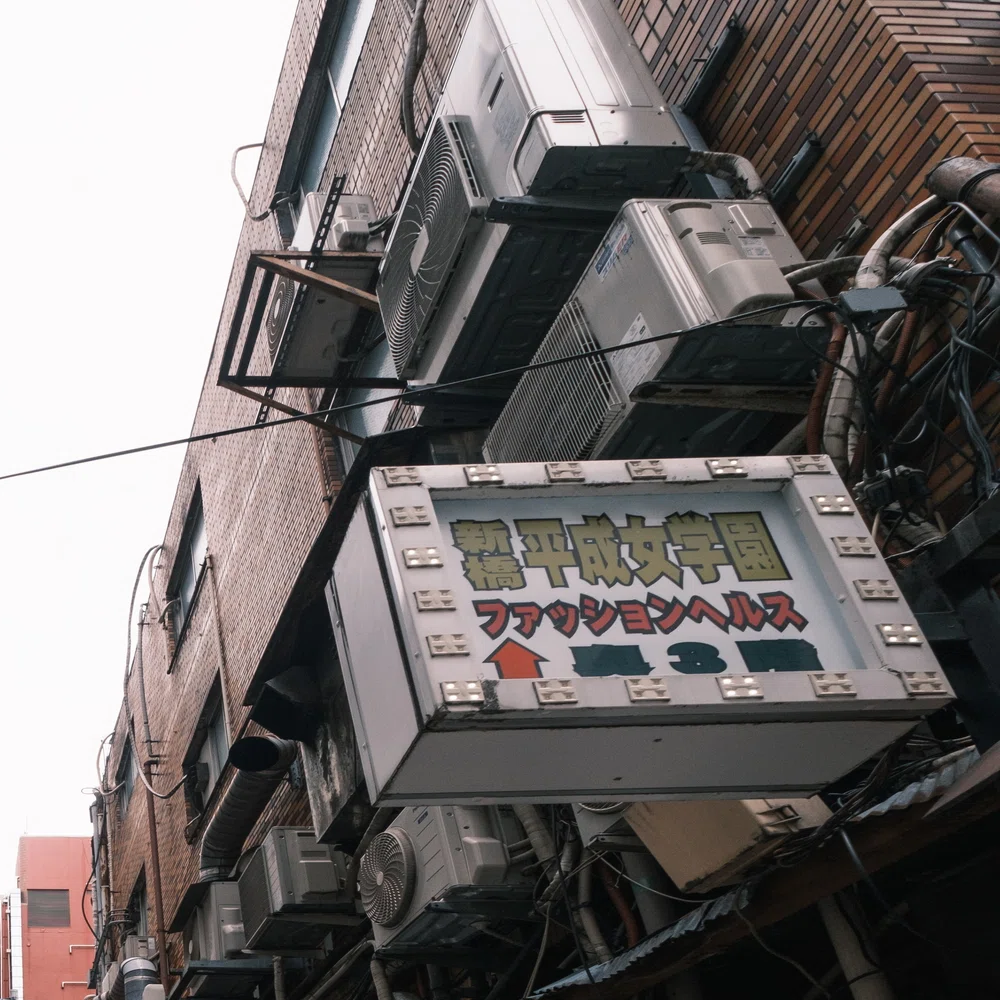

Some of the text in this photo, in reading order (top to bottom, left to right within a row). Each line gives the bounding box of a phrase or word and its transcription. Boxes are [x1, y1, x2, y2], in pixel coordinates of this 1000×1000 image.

[449, 510, 793, 591] 新橋 平成女学園
[476, 592, 808, 640] ファッションヘルス
